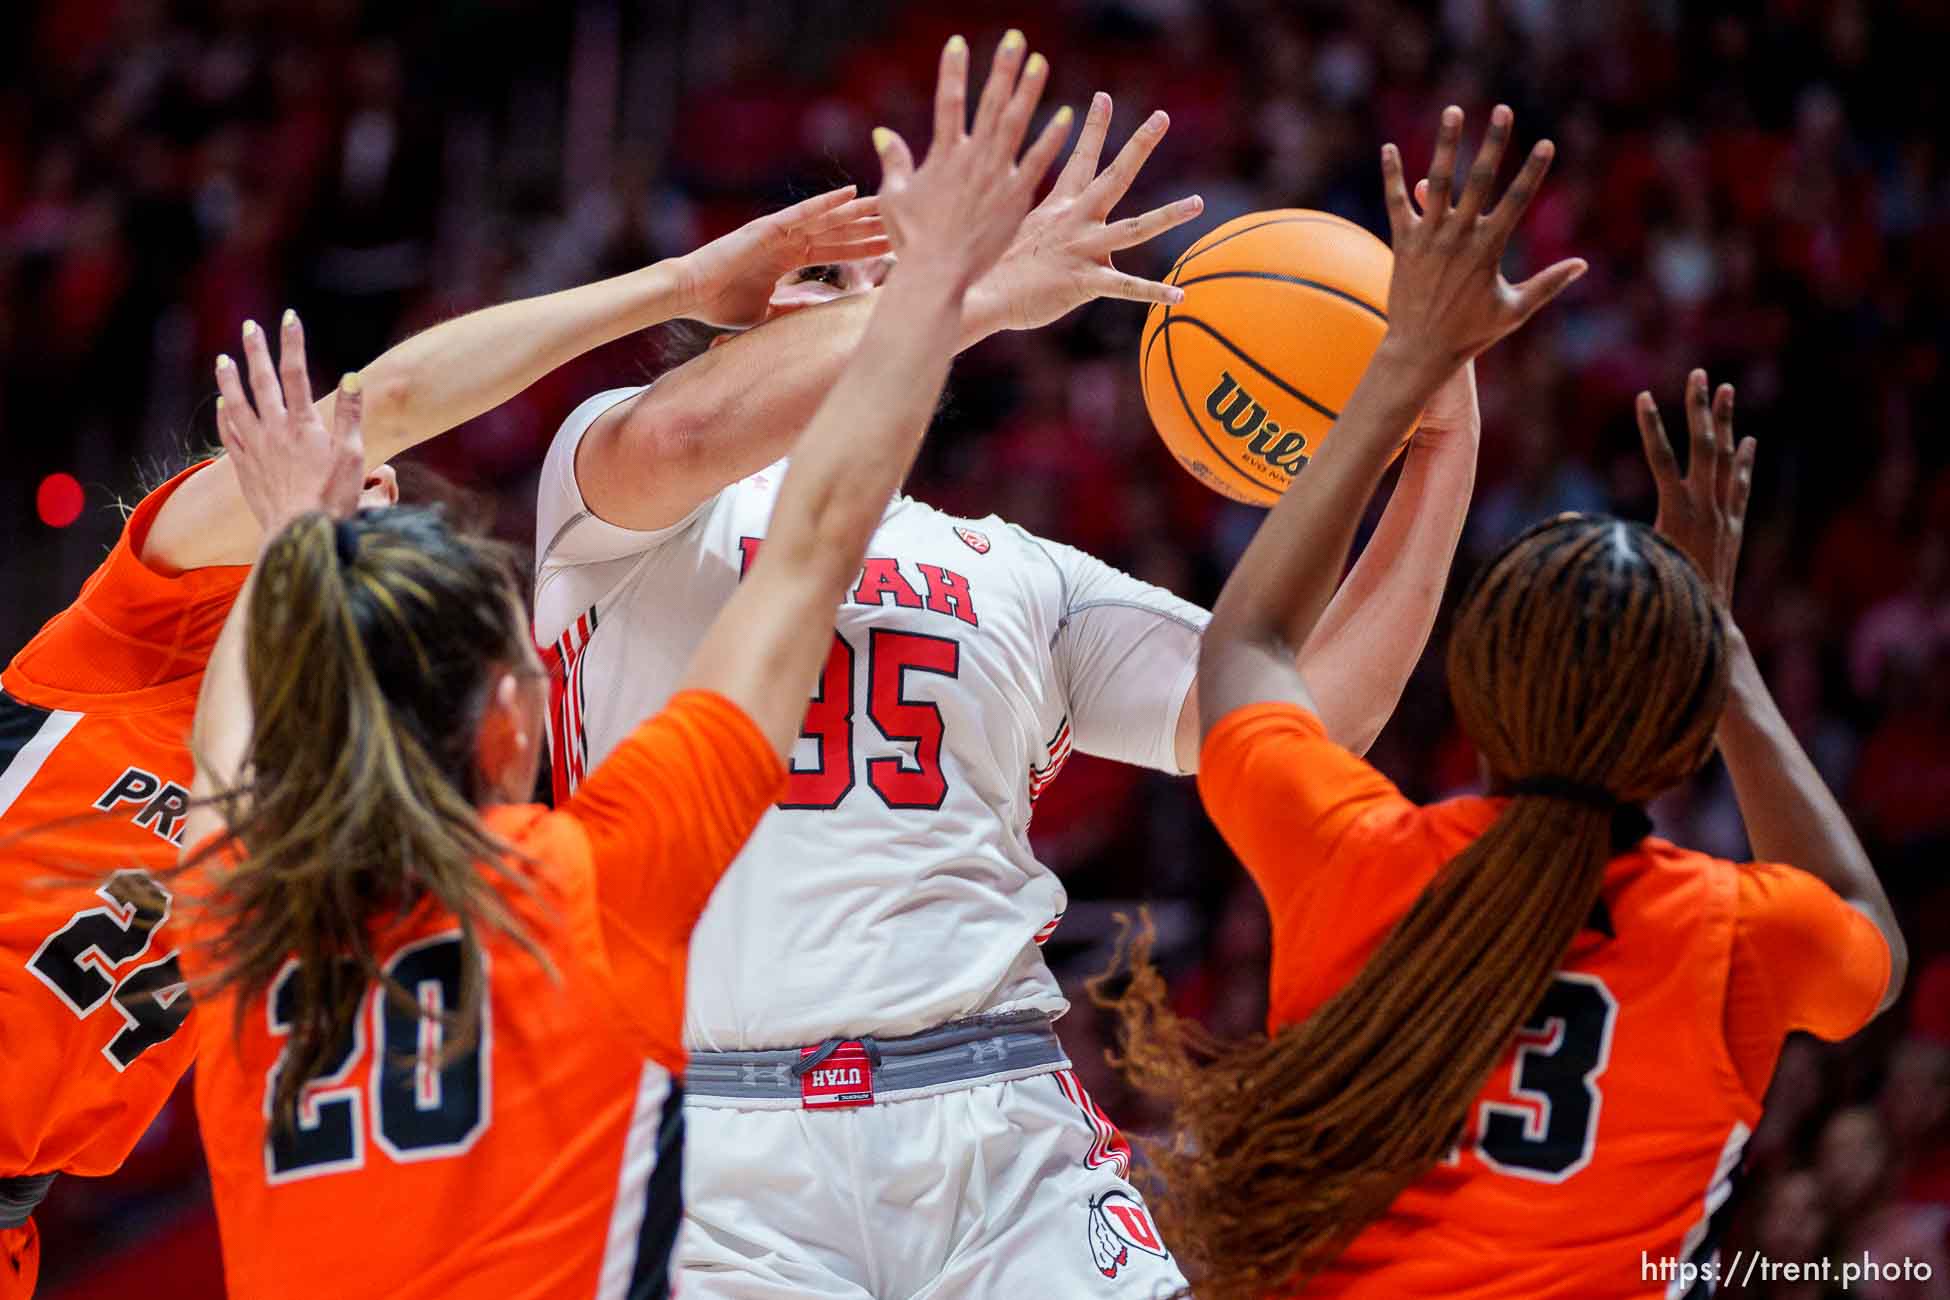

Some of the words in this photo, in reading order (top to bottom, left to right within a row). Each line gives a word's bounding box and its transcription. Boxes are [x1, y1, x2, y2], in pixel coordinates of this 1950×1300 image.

[738, 535, 979, 628] AH
[92, 766, 192, 849] PR
[25, 868, 196, 1073] 24
[262, 927, 493, 1187] 20
[811, 1067, 862, 1088] UTAH
